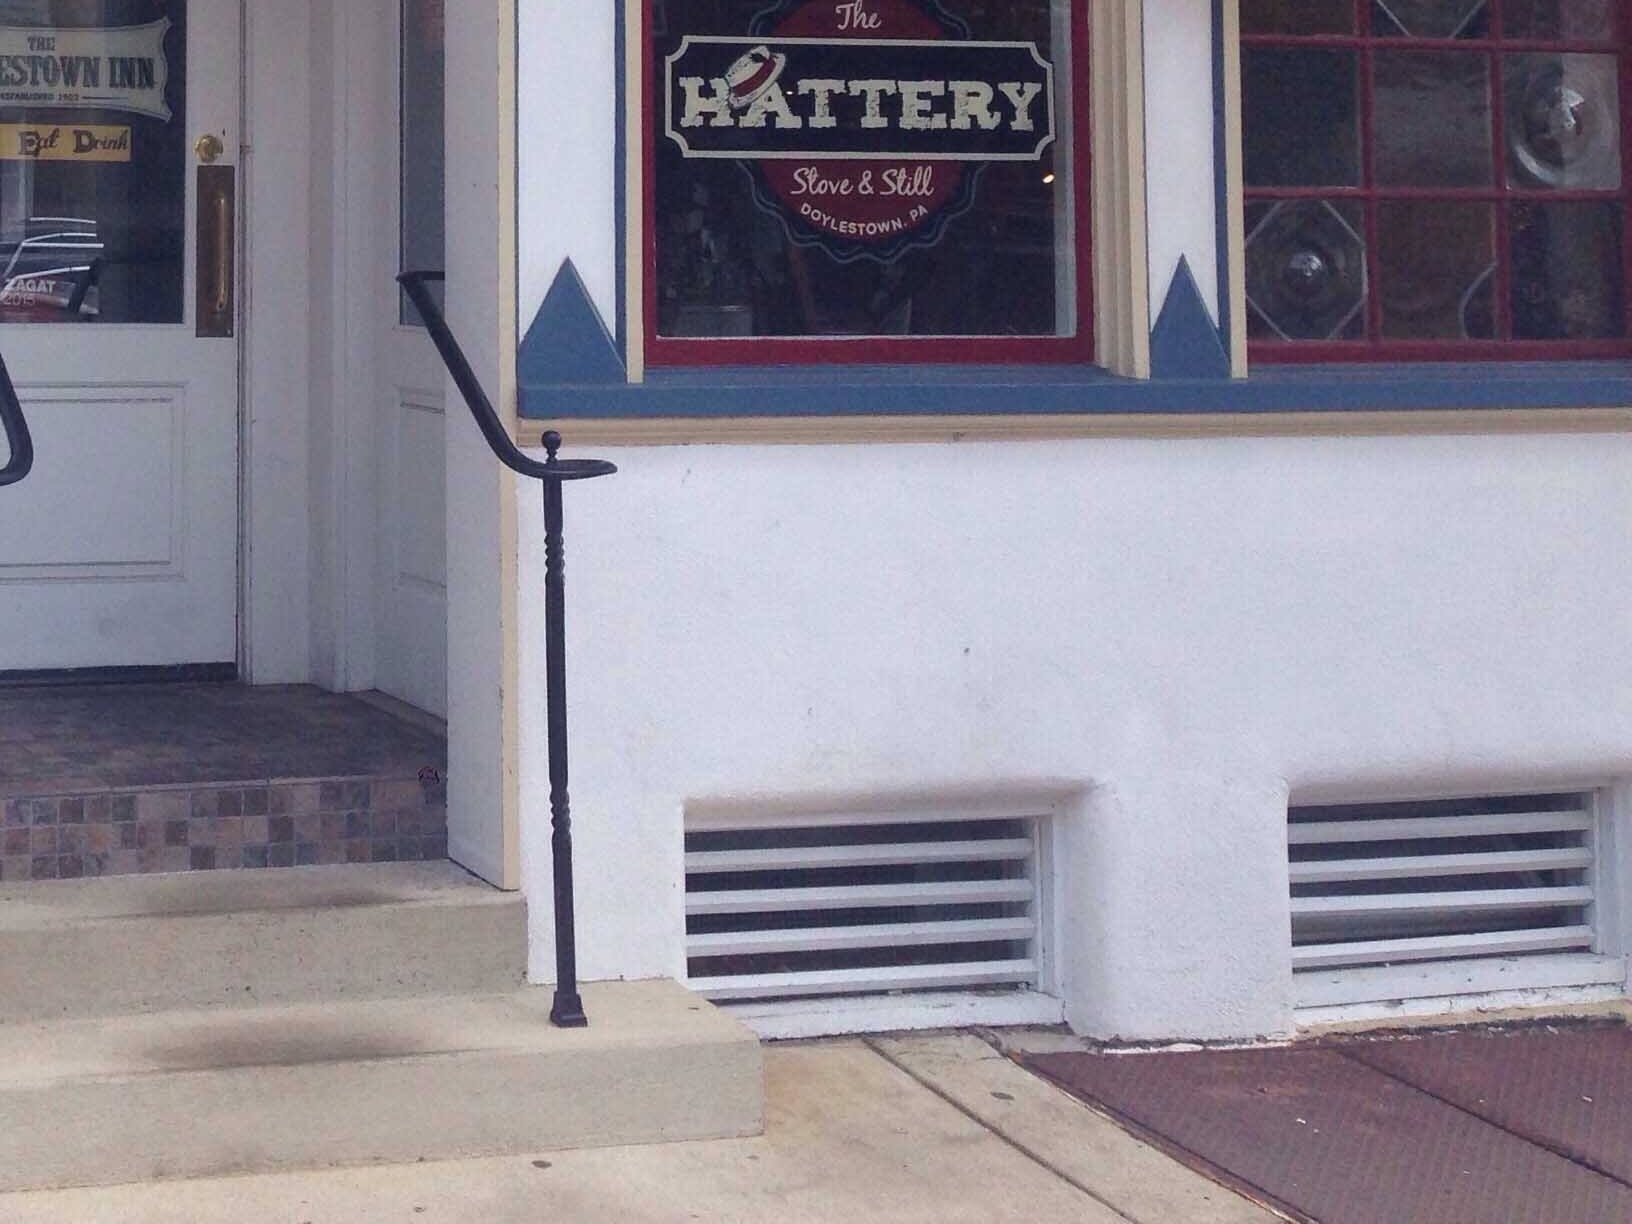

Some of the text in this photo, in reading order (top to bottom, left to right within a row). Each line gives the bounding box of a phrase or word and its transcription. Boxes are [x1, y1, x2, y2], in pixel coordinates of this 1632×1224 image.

[27, 36, 56, 51] THE
[108, 56, 155, 91] INN
[679, 76, 1043, 132] HATTERY
[18, 126, 61, 158] Eat
[73, 128, 130, 154] Drink
[790, 166, 935, 197] Stove & Still
[909, 204, 929, 222] PA
